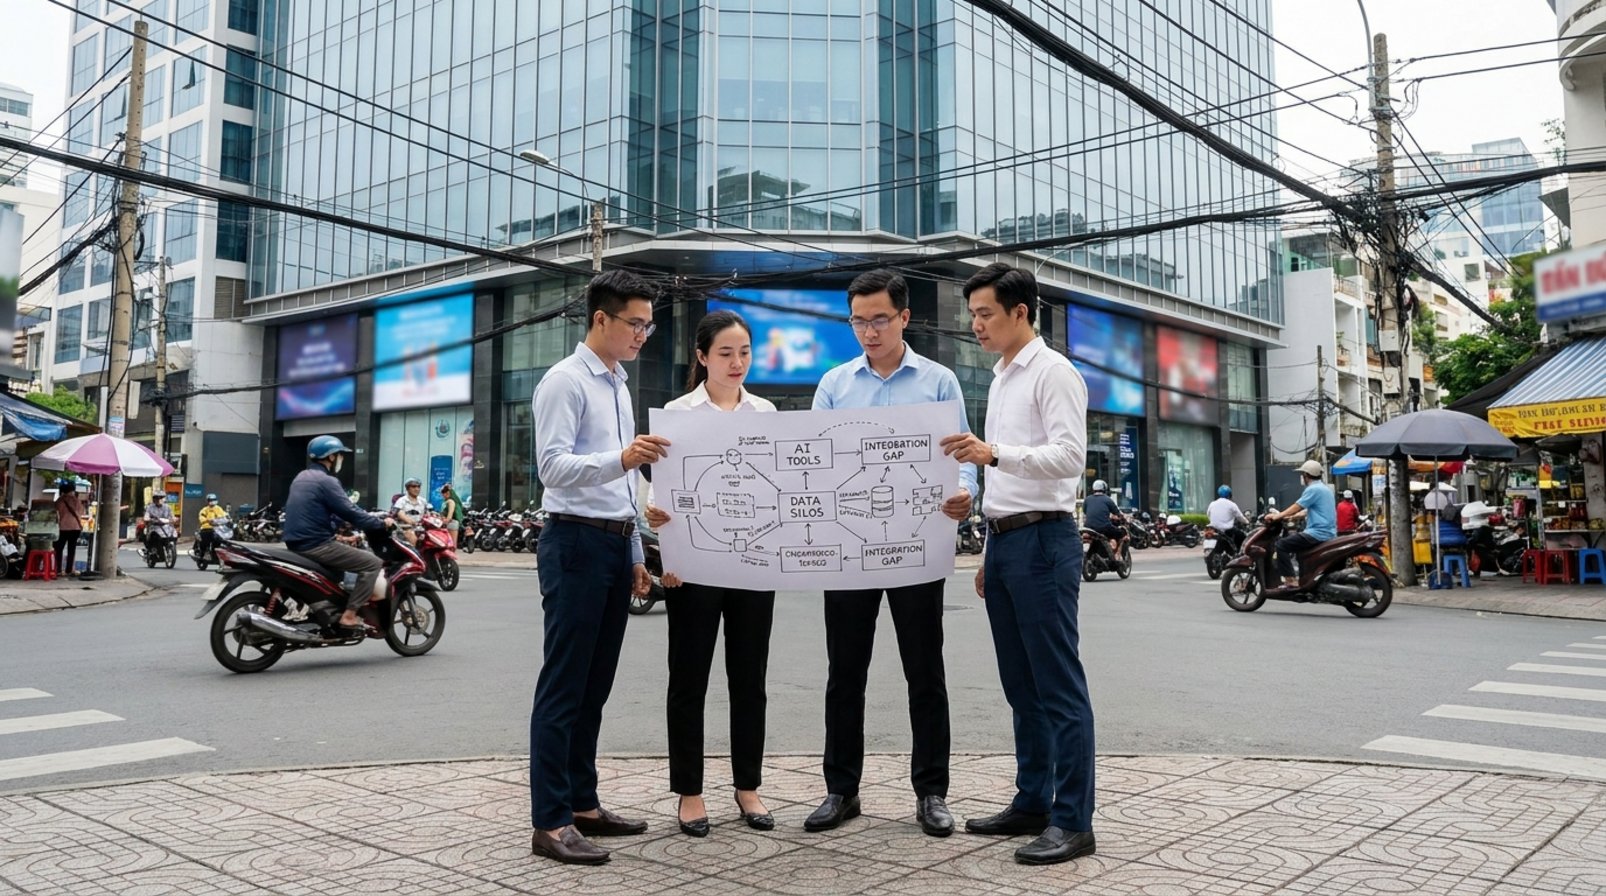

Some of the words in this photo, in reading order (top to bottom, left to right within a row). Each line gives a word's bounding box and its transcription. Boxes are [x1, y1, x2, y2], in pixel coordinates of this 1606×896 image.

[794, 442, 811, 454] AI
[786, 455, 821, 466] TOOLS
[882, 450, 904, 461] GAP
[790, 496, 821, 506] DATA
[790, 507, 824, 518] SILOS
[881, 556, 903, 566] GAP
